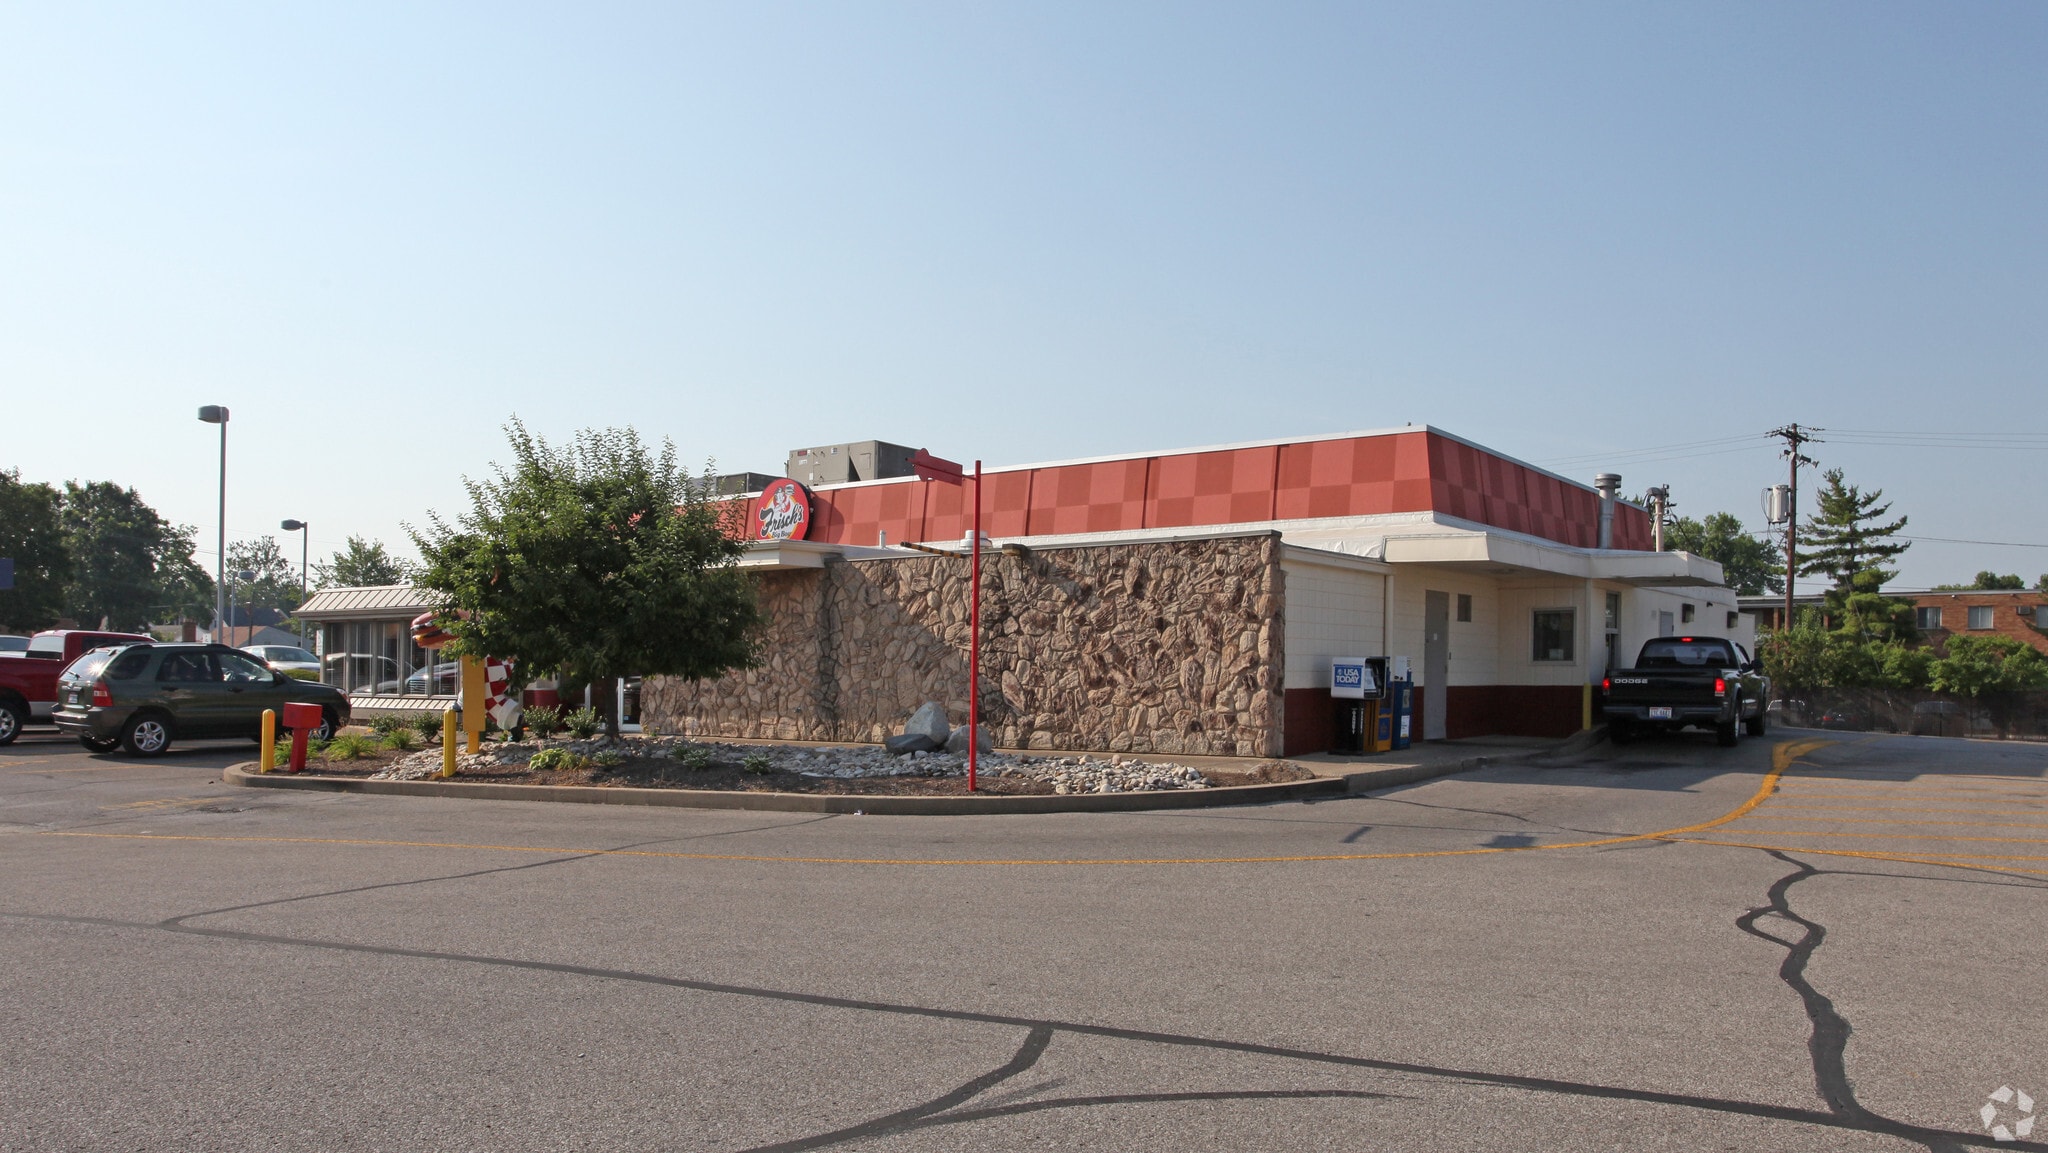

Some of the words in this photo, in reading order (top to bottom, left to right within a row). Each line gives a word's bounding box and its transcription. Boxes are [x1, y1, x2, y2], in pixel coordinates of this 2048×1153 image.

[760, 503, 803, 537] Frisch's
[1343, 668, 1359, 676] USA
[1336, 675, 1360, 684] TODAY
